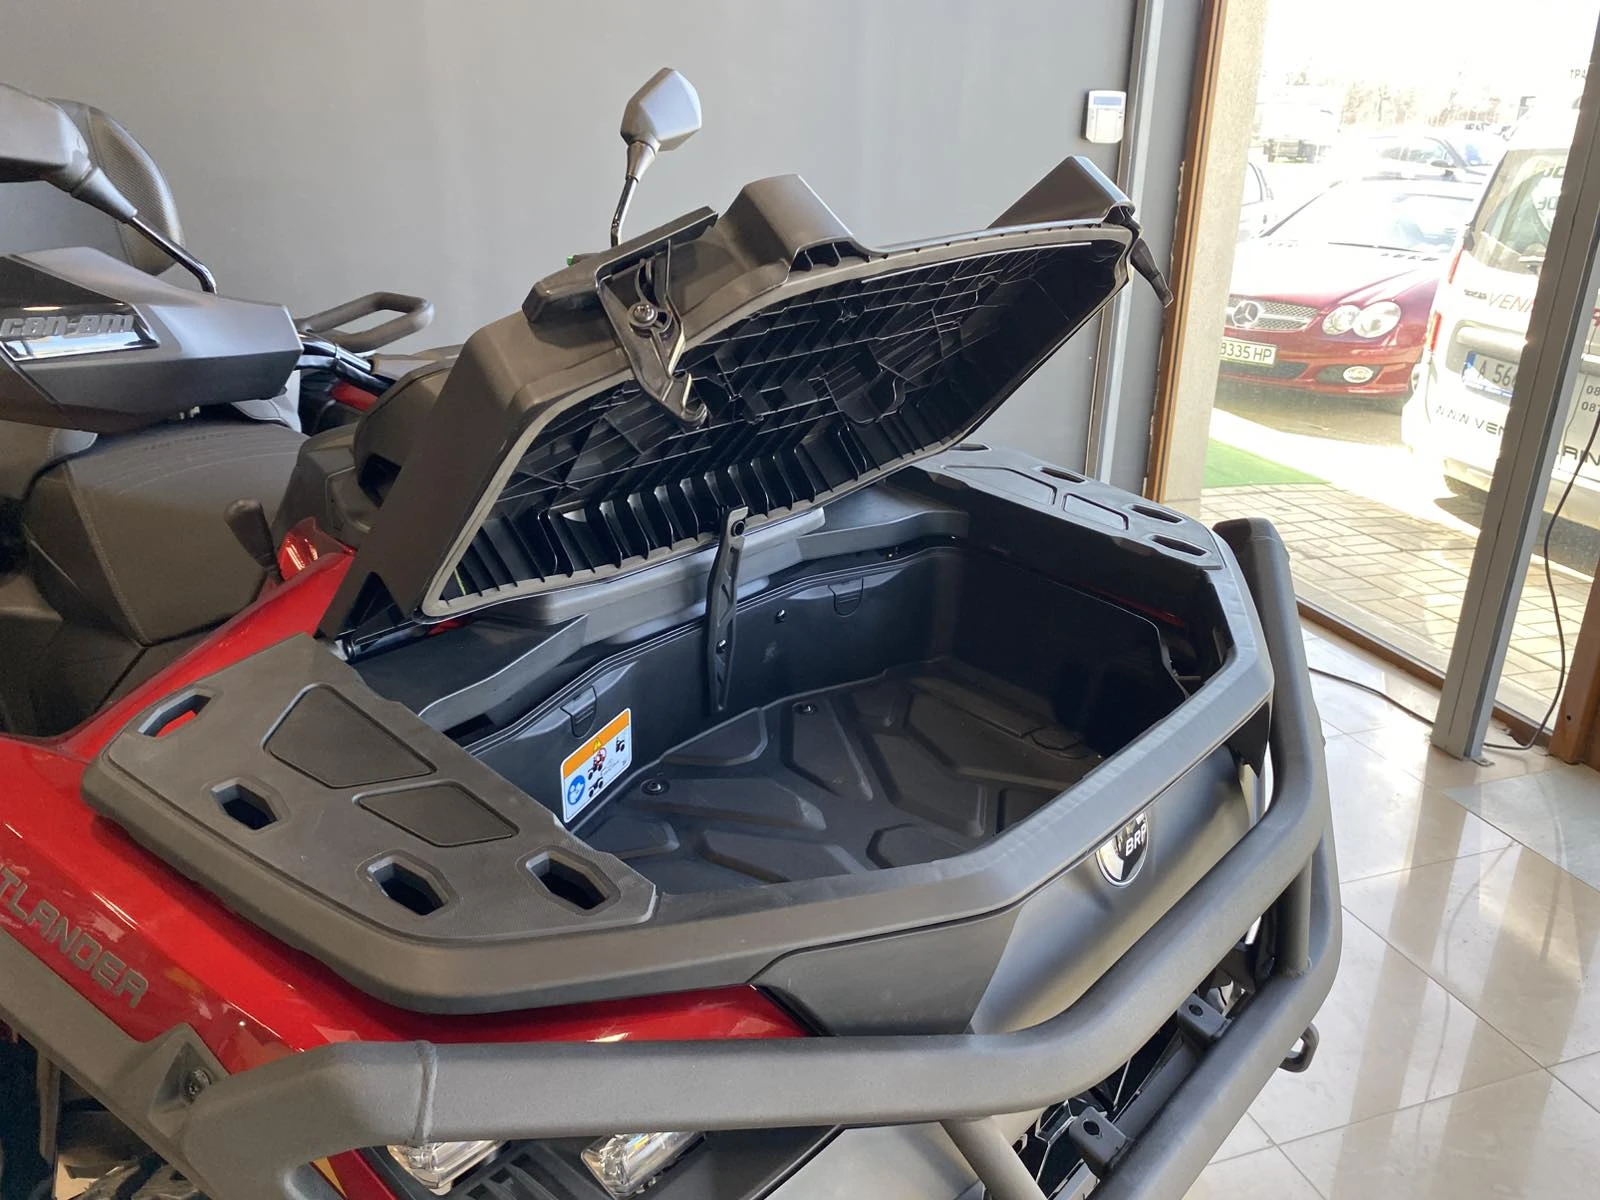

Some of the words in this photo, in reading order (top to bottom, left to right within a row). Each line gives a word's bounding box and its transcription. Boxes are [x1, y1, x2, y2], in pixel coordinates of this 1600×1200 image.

[1253, 347, 1272, 362] HP
[1581, 401, 1600, 412] 08
[1125, 823, 1147, 857] BRP
[0, 863, 149, 1009] TLANDER
